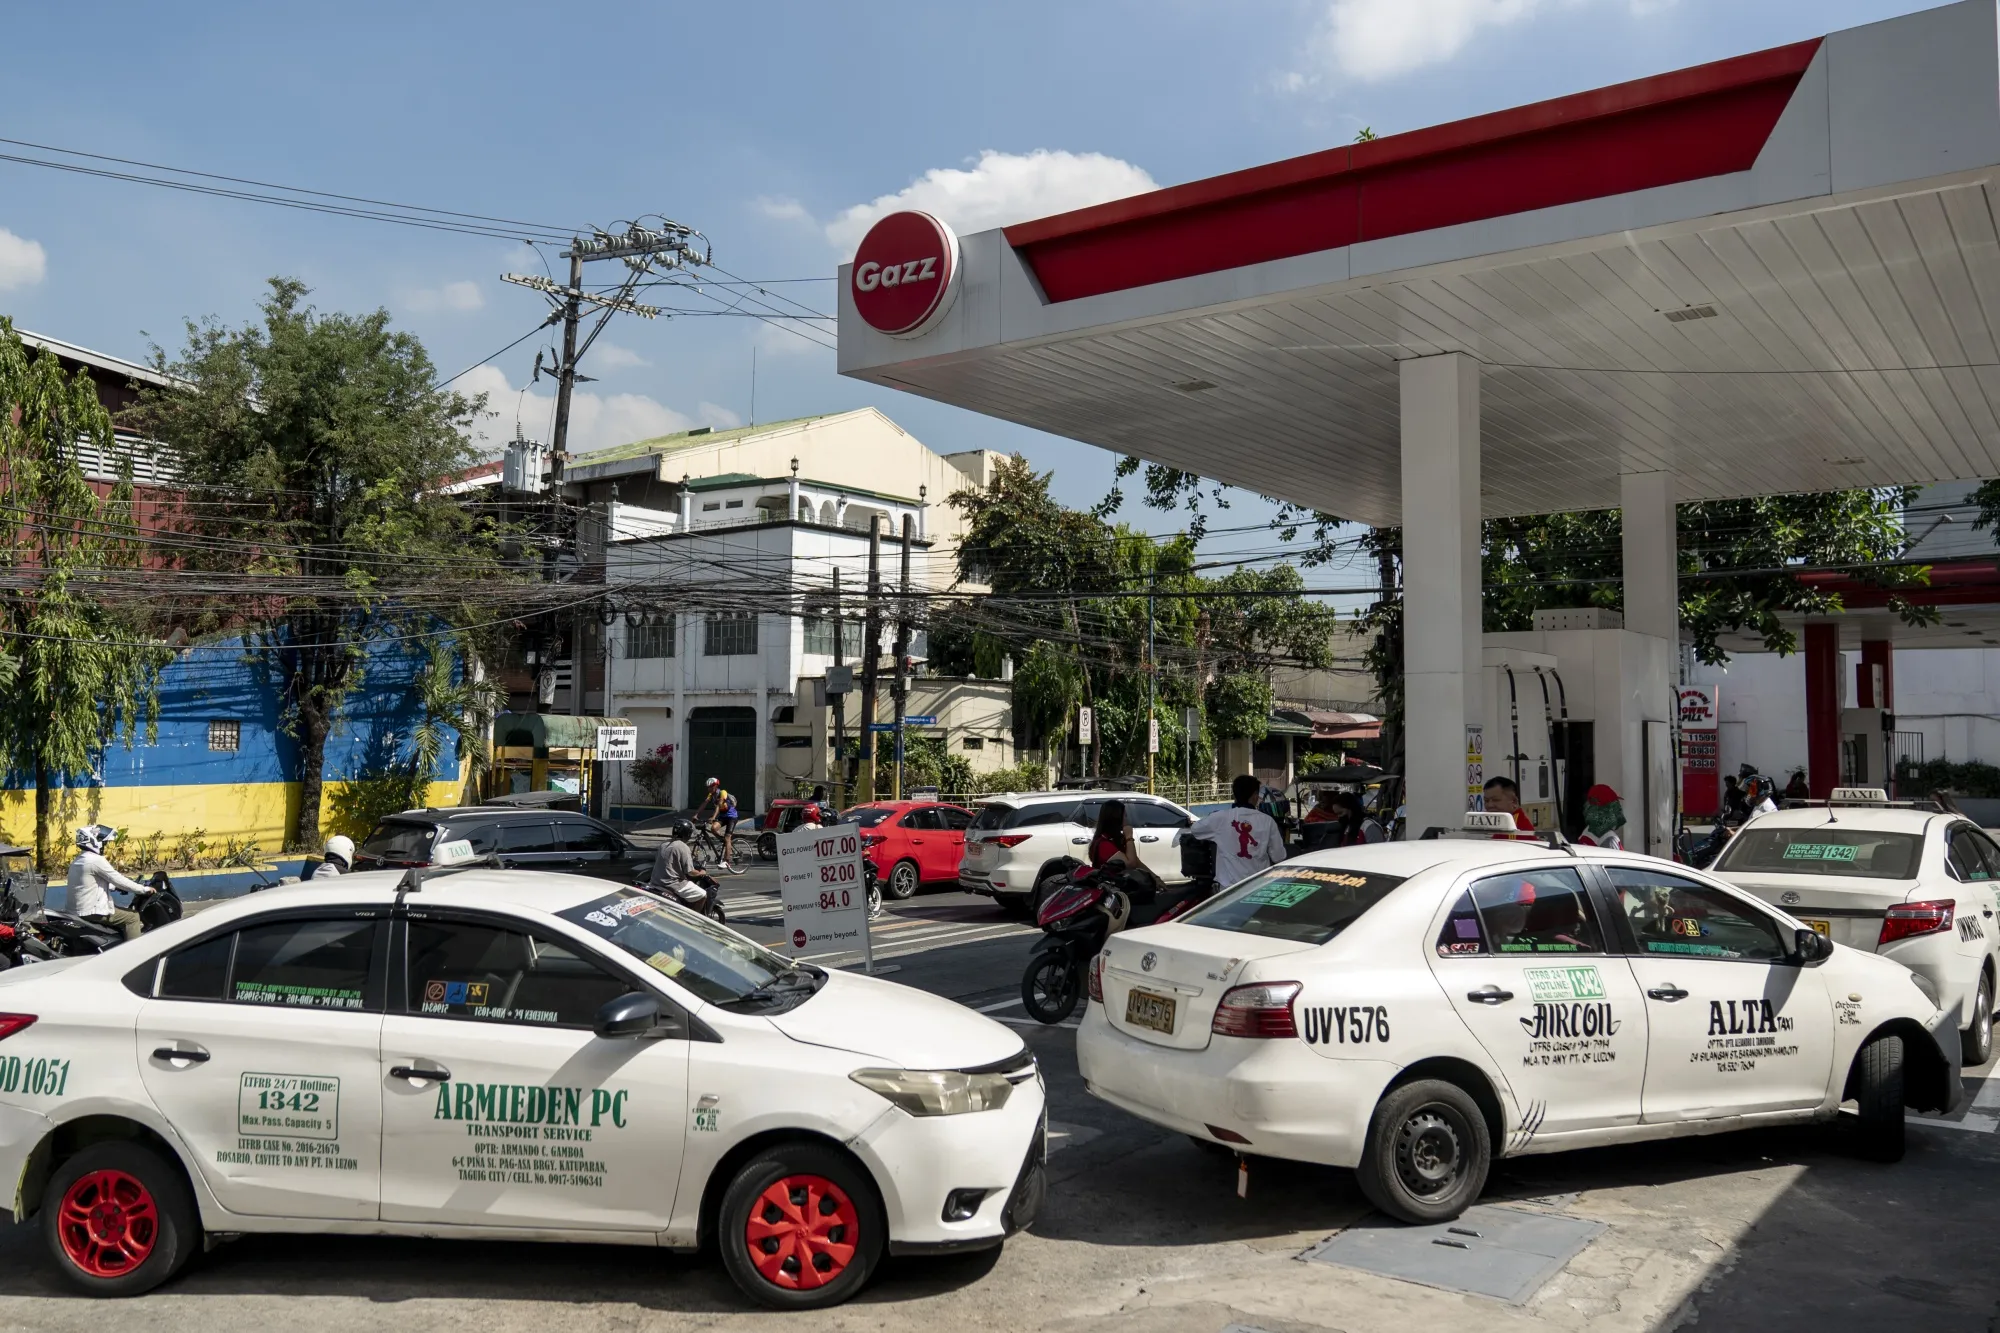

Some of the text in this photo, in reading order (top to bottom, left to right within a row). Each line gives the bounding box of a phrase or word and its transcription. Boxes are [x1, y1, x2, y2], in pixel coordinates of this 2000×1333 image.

[856, 257, 937, 292] Gazz
[1680, 707, 1713, 718] OWER
[601, 750, 634, 758] To MAKATI
[1840, 790, 1873, 799] TAXI
[1470, 815, 1498, 826] TAXI
[448, 844, 469, 857] TAXI
[814, 836, 857, 857] 107.00
[1827, 847, 1853, 859] 1342
[791, 873, 806, 881] PRIME
[793, 902, 814, 911] PREMIUM
[809, 930, 859, 942] Journey beyond.
[1450, 943, 1480, 953] SAFE
[1527, 970, 1551, 980] LTFRB
[1570, 969, 1603, 996] 1342
[1534, 981, 1570, 990] HOTLINE:
[1708, 998, 1794, 1036] ALTA TAXI
[1304, 1005, 1390, 1045] UVY576
[1530, 1041, 1552, 1053] LTFRB
[1541, 1055, 1550, 1066] TO
[1552, 1054, 1567, 1065] ANY
[1582, 1052, 1592, 1063] OF
[1594, 1051, 1616, 1063] LUZON
[244, 1076, 336, 1093] LTFRB 24/7 Hotline:
[258, 1089, 320, 1113] 1342
[434, 1081, 629, 1129] ARMIEDEN PC
[242, 1114, 332, 1130] Max. Pass. Capacity 5
[696, 1113, 705, 1126] 6
[466, 1123, 593, 1142] TRANSPORT SERVICE
[238, 1137, 340, 1155] LTFRB CASE No. 2016-21679
[474, 1142, 584, 1159] OPTR: ARMANDO C. GAMBOA
[216, 1150, 358, 1171] ROSARIO, CAVITE TO ANY PT. IN LUZON
[452, 1155, 465, 1168] 6-C
[466, 1154, 485, 1168] PIÑA
[499, 1157, 531, 1171] PAG-ASA
[533, 1158, 558, 1172] BRGY.
[559, 1159, 608, 1174] KATUPARAN,
[458, 1168, 487, 1182] TAGUIG
[488, 1170, 506, 1183] CITY
[513, 1171, 533, 1184] CELL.
[534, 1172, 547, 1185] No.
[548, 1173, 603, 1188] 0917-5196341
